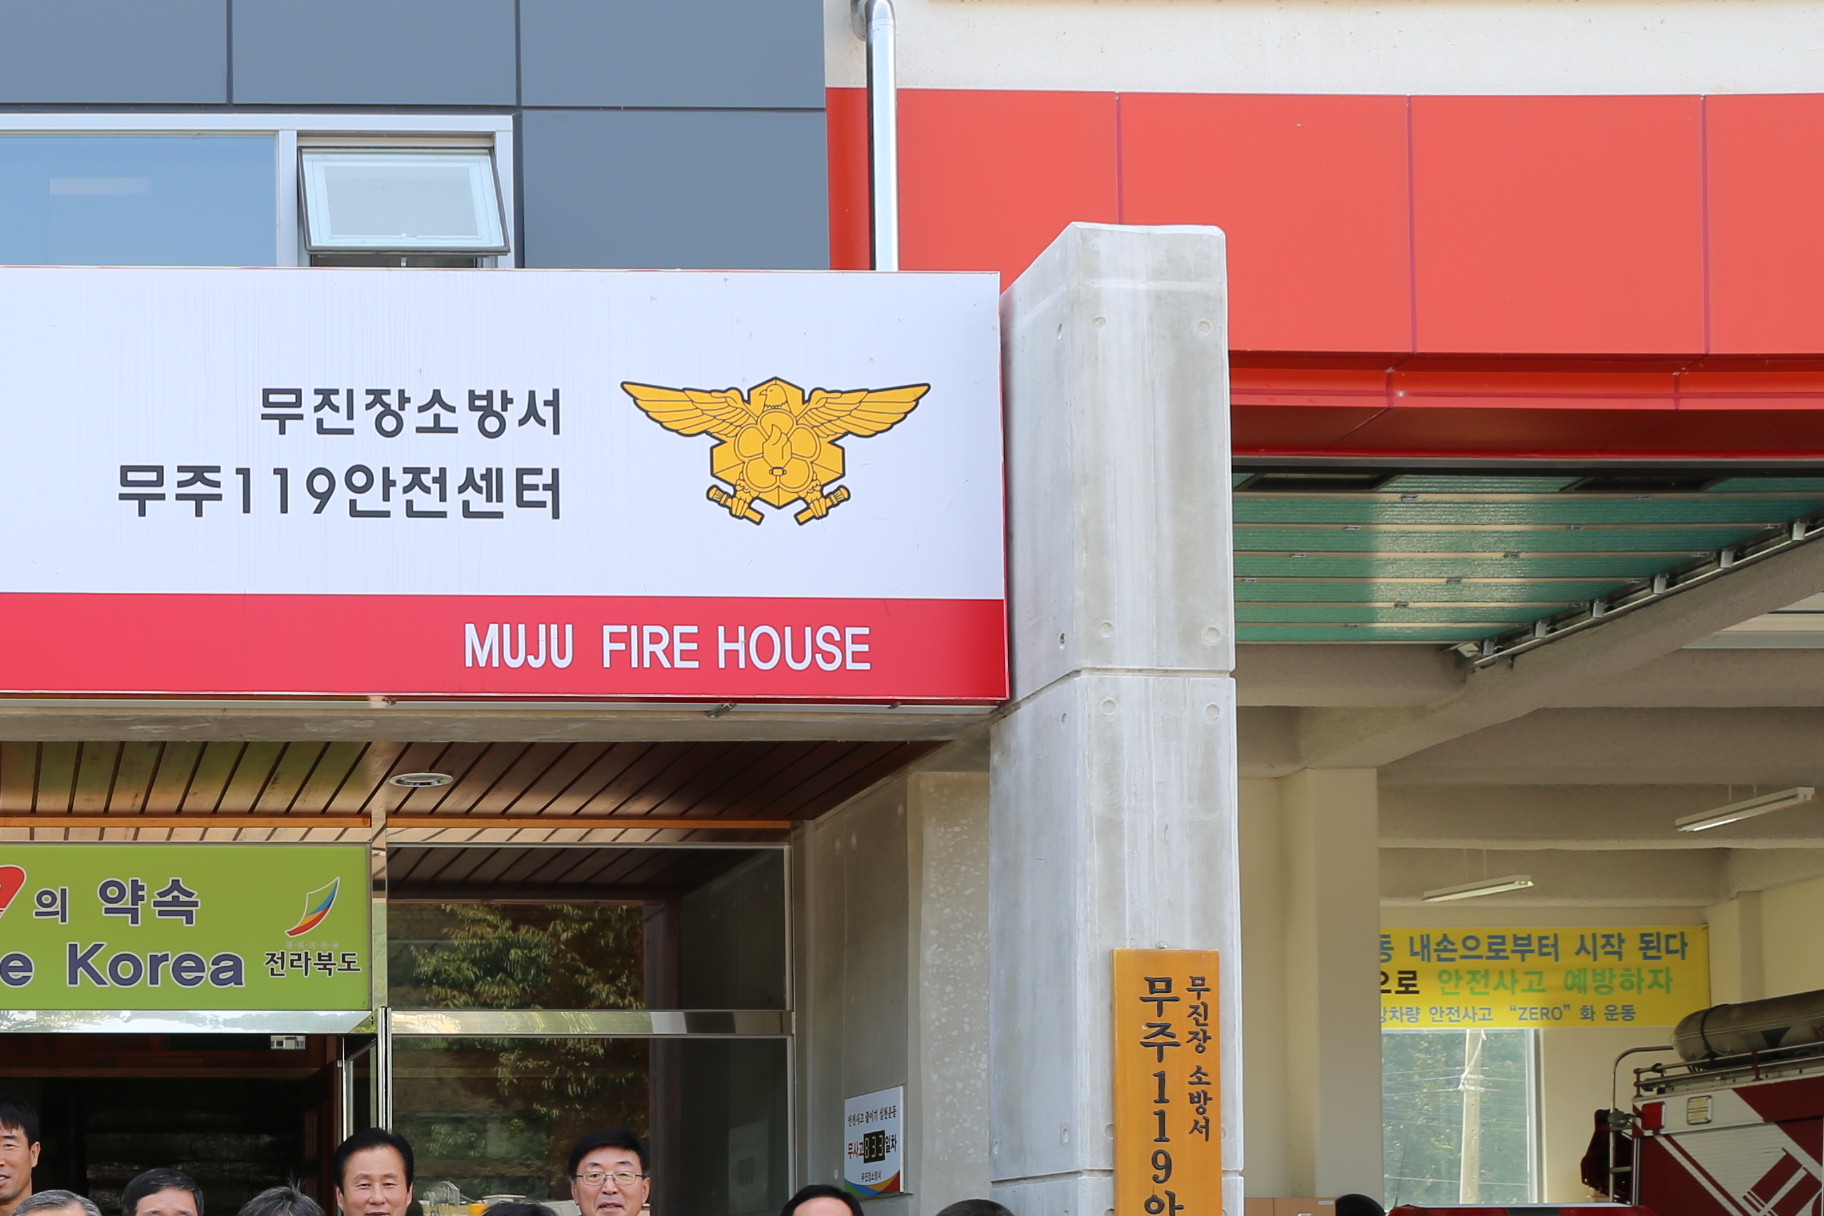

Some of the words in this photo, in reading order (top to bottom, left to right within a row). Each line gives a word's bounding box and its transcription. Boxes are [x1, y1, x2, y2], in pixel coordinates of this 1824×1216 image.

[259, 387, 563, 440] 무진장소방서
[117, 463, 563, 521] 무주119안전센터
[463, 622, 574, 671] MUJU
[602, 624, 700, 671] FIRE
[717, 625, 872, 673] HOUSE
[98, 877, 201, 926] 약속
[66, 941, 246, 988] Korea
[264, 950, 362, 978] 전라북도
[1574, 931, 1627, 962] 시작
[1638, 930, 1689, 961] 된다
[1436, 968, 1547, 997] 안전사고
[1562, 967, 1674, 997] 예방하자
[1428, 1005, 1495, 1024] 안전사고
[1603, 1004, 1637, 1022] 운동
